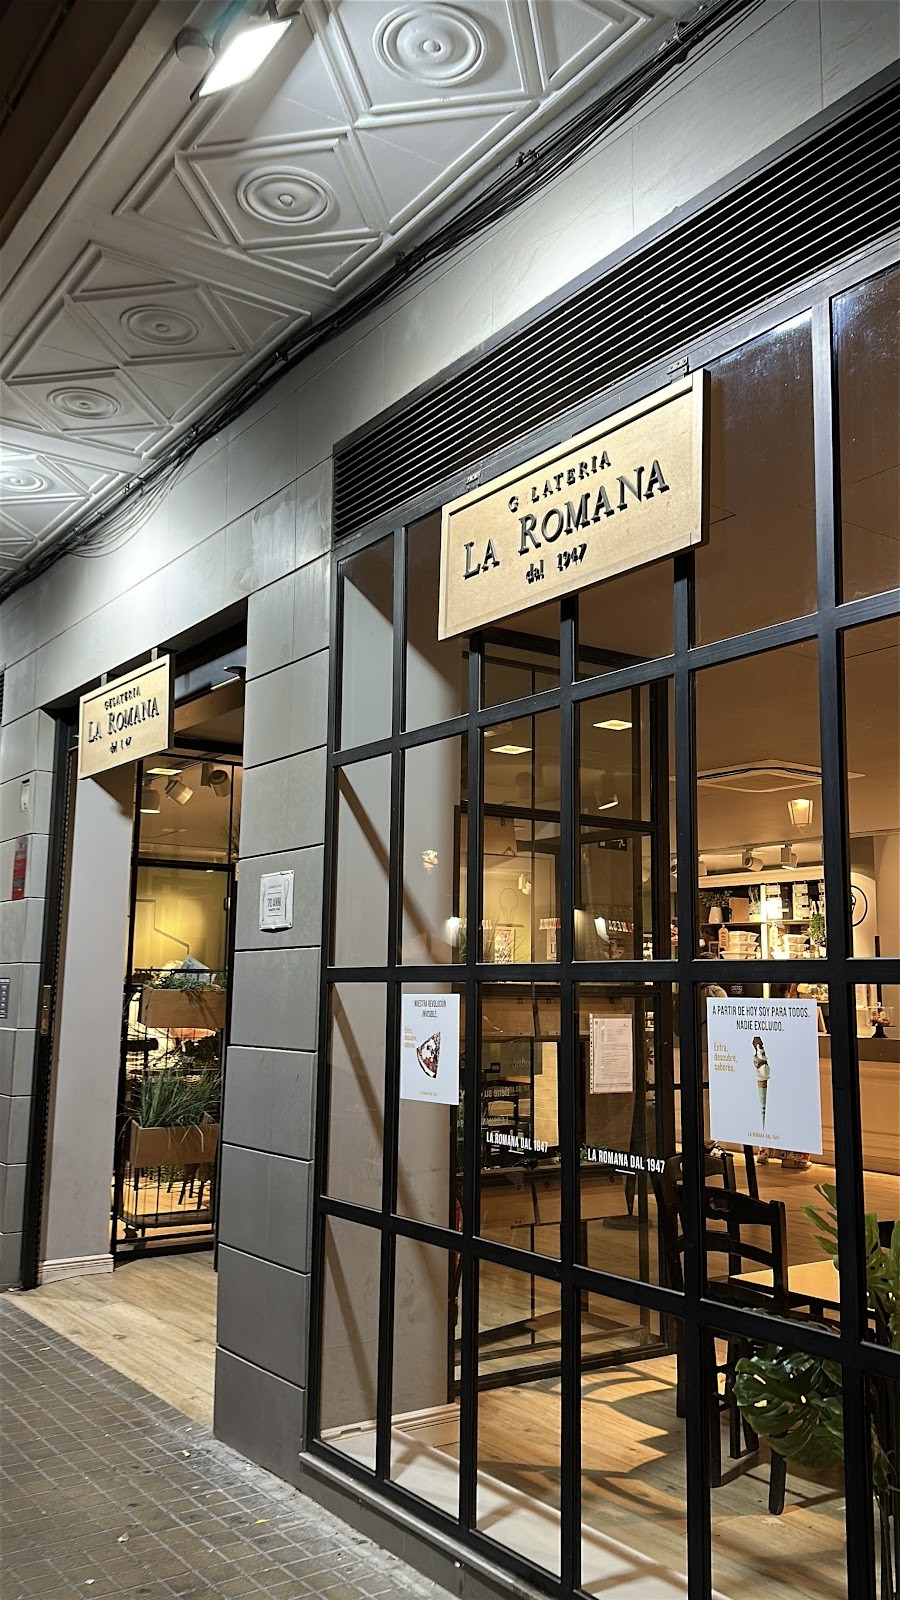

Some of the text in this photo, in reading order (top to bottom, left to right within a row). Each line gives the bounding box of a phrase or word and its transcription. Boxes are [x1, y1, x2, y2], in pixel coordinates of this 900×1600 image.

[508, 450, 612, 513] GLATERIA
[463, 459, 670, 580] LA ROMANA
[557, 543, 588, 572] 1947
[88, 697, 160, 743] LA ROMANA
[712, 1005, 811, 1018] A PARTIR DE HOY SOY PARA TODOS.
[736, 1020, 785, 1031] NADIE EXCLUIDO.
[486, 1131, 548, 1153] LA ROMANA DAL 1947
[587, 1147, 666, 1174] LA ROMANA DAL 1947
